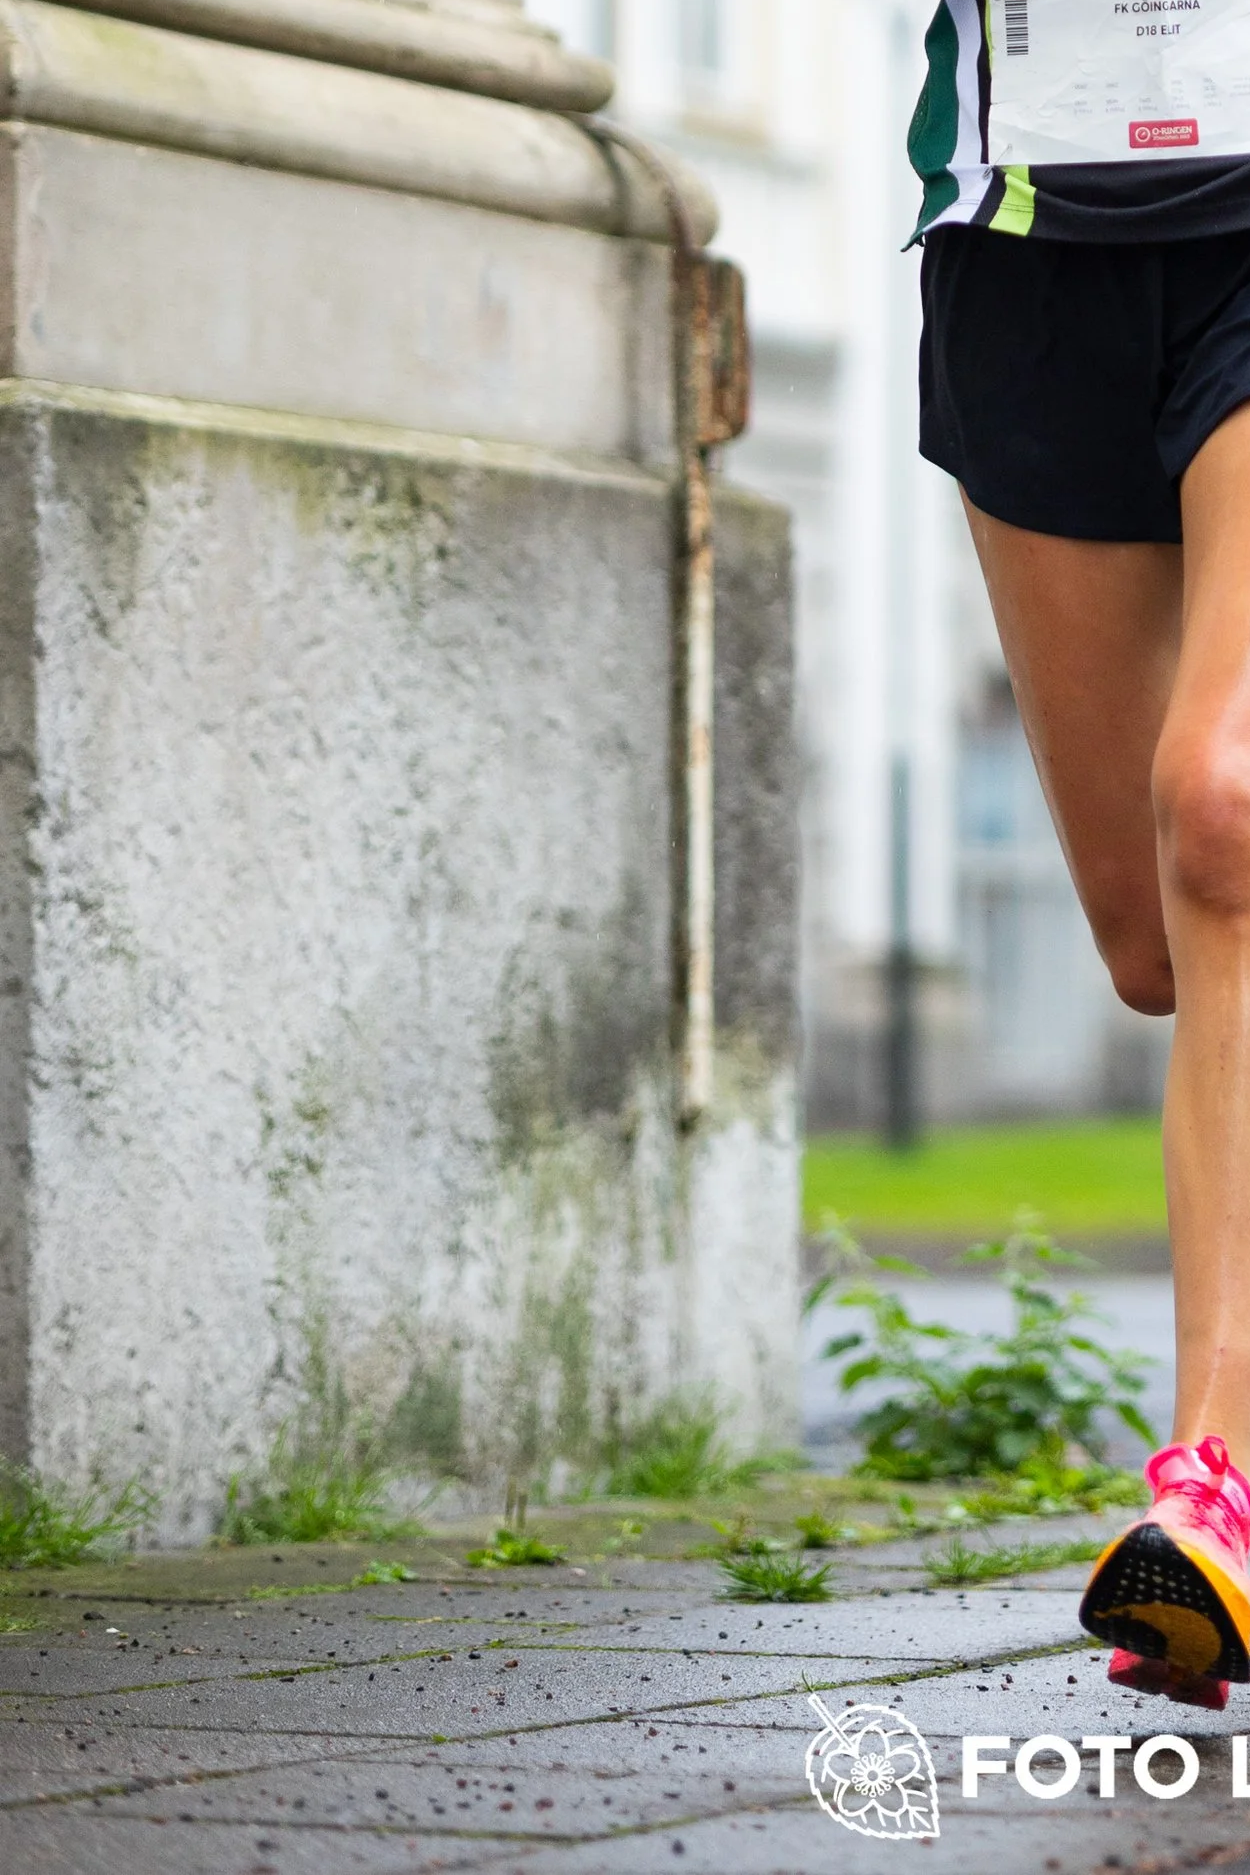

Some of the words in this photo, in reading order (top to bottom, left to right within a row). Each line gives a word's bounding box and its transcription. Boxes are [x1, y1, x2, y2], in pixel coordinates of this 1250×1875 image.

[1114, 2, 1129, 13] FK
[1136, 25, 1157, 36] D18
[1161, 24, 1181, 35] ELIT
